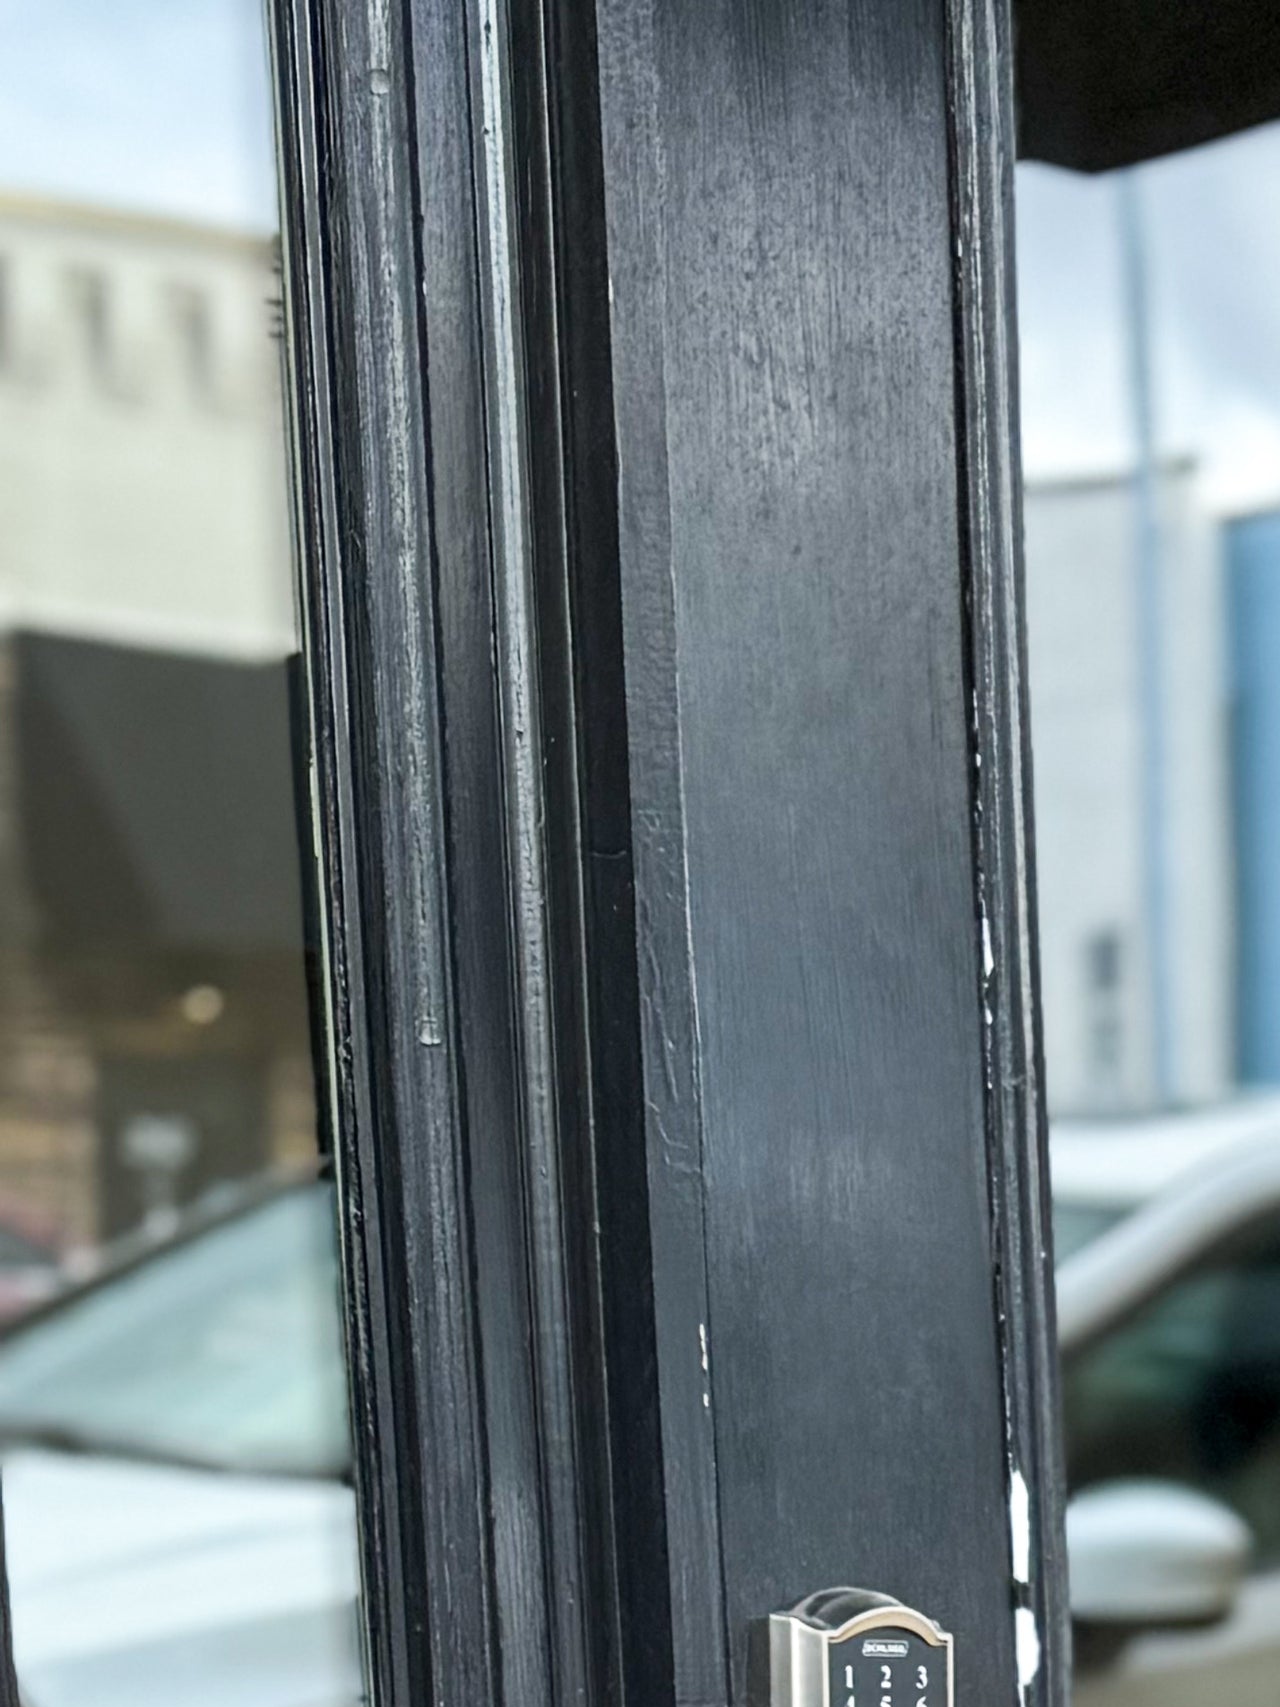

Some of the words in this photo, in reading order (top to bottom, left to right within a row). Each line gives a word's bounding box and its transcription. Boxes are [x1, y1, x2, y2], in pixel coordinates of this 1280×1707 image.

[844, 1665, 854, 1689] 1
[880, 1665, 892, 1689] 2
[915, 1665, 928, 1689] 3
